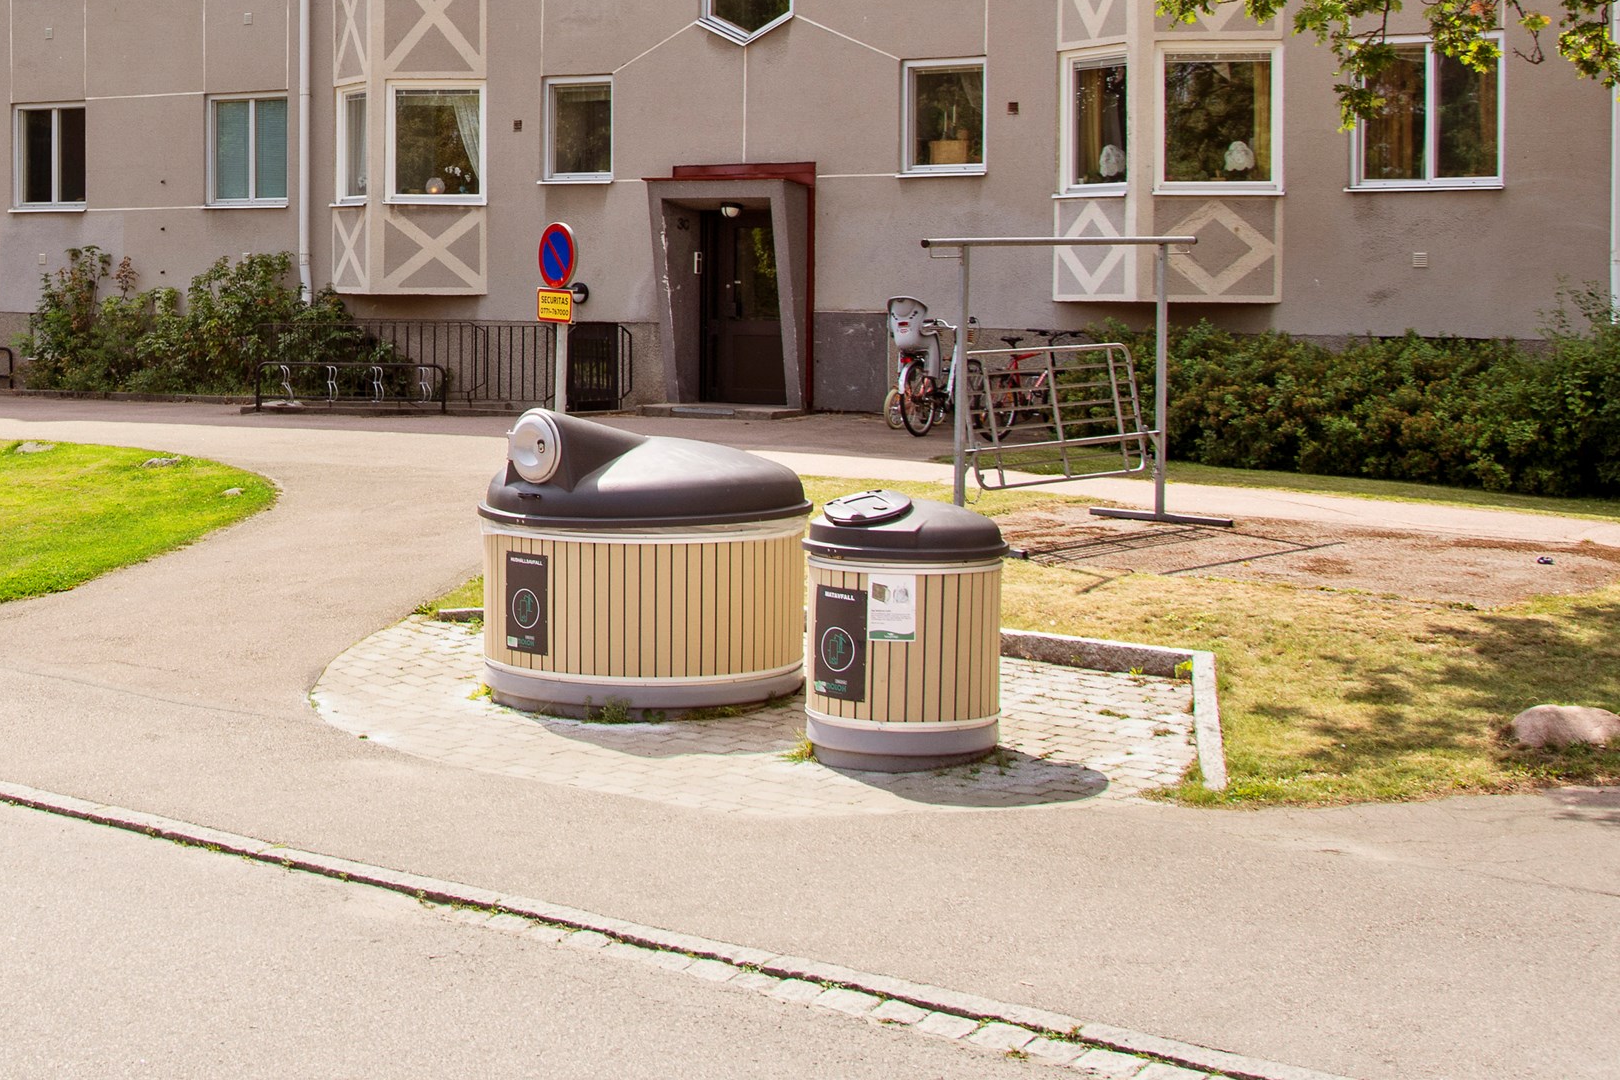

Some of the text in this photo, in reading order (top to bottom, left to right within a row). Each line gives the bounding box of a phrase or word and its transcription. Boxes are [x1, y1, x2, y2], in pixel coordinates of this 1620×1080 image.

[540, 295, 569, 305] SECURITAS
[540, 307, 569, 316] 0771-767000
[824, 590, 856, 601] MATAVFALL
